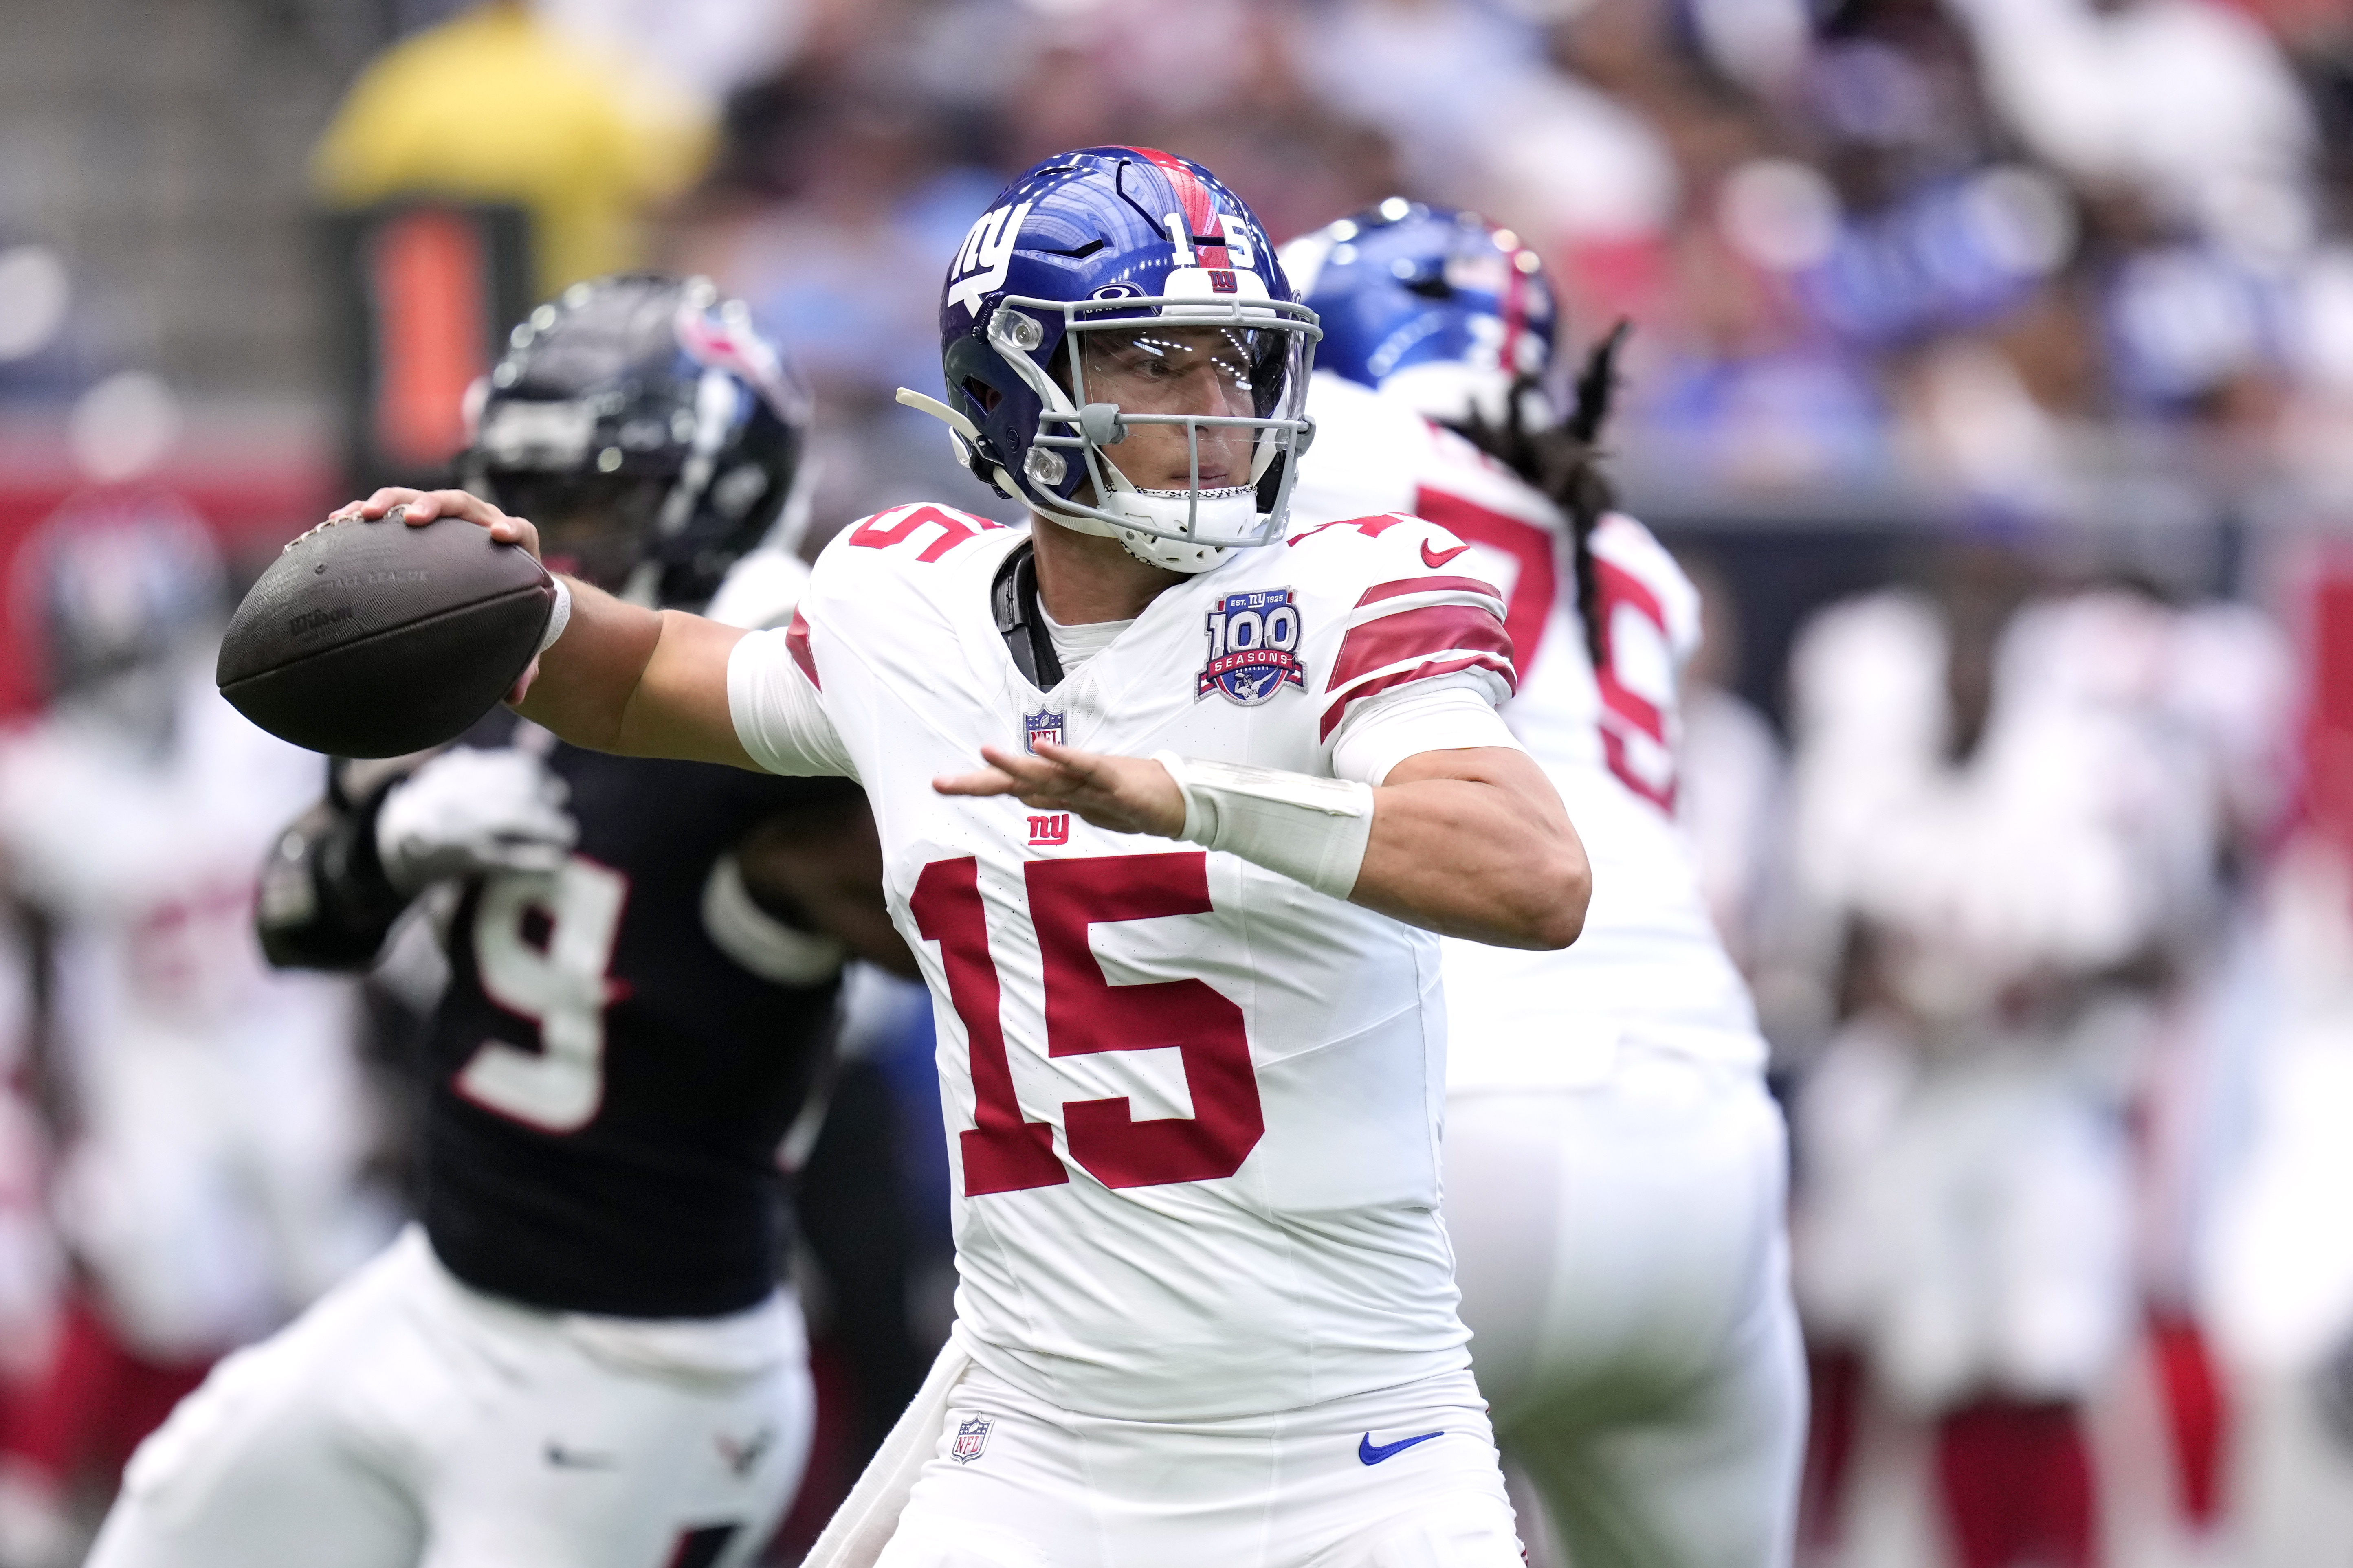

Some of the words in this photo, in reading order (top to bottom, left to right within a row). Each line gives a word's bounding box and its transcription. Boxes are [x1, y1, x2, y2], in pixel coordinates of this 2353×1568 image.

[1163, 213, 1255, 269] 15
[1267, 595, 1284, 603] 1925
[289, 606, 353, 635] Wilson
[1208, 606, 1299, 661] 100
[1214, 652, 1288, 672] SEASONS
[909, 851, 1264, 1197] 15
[954, 1436, 979, 1455] NFL
